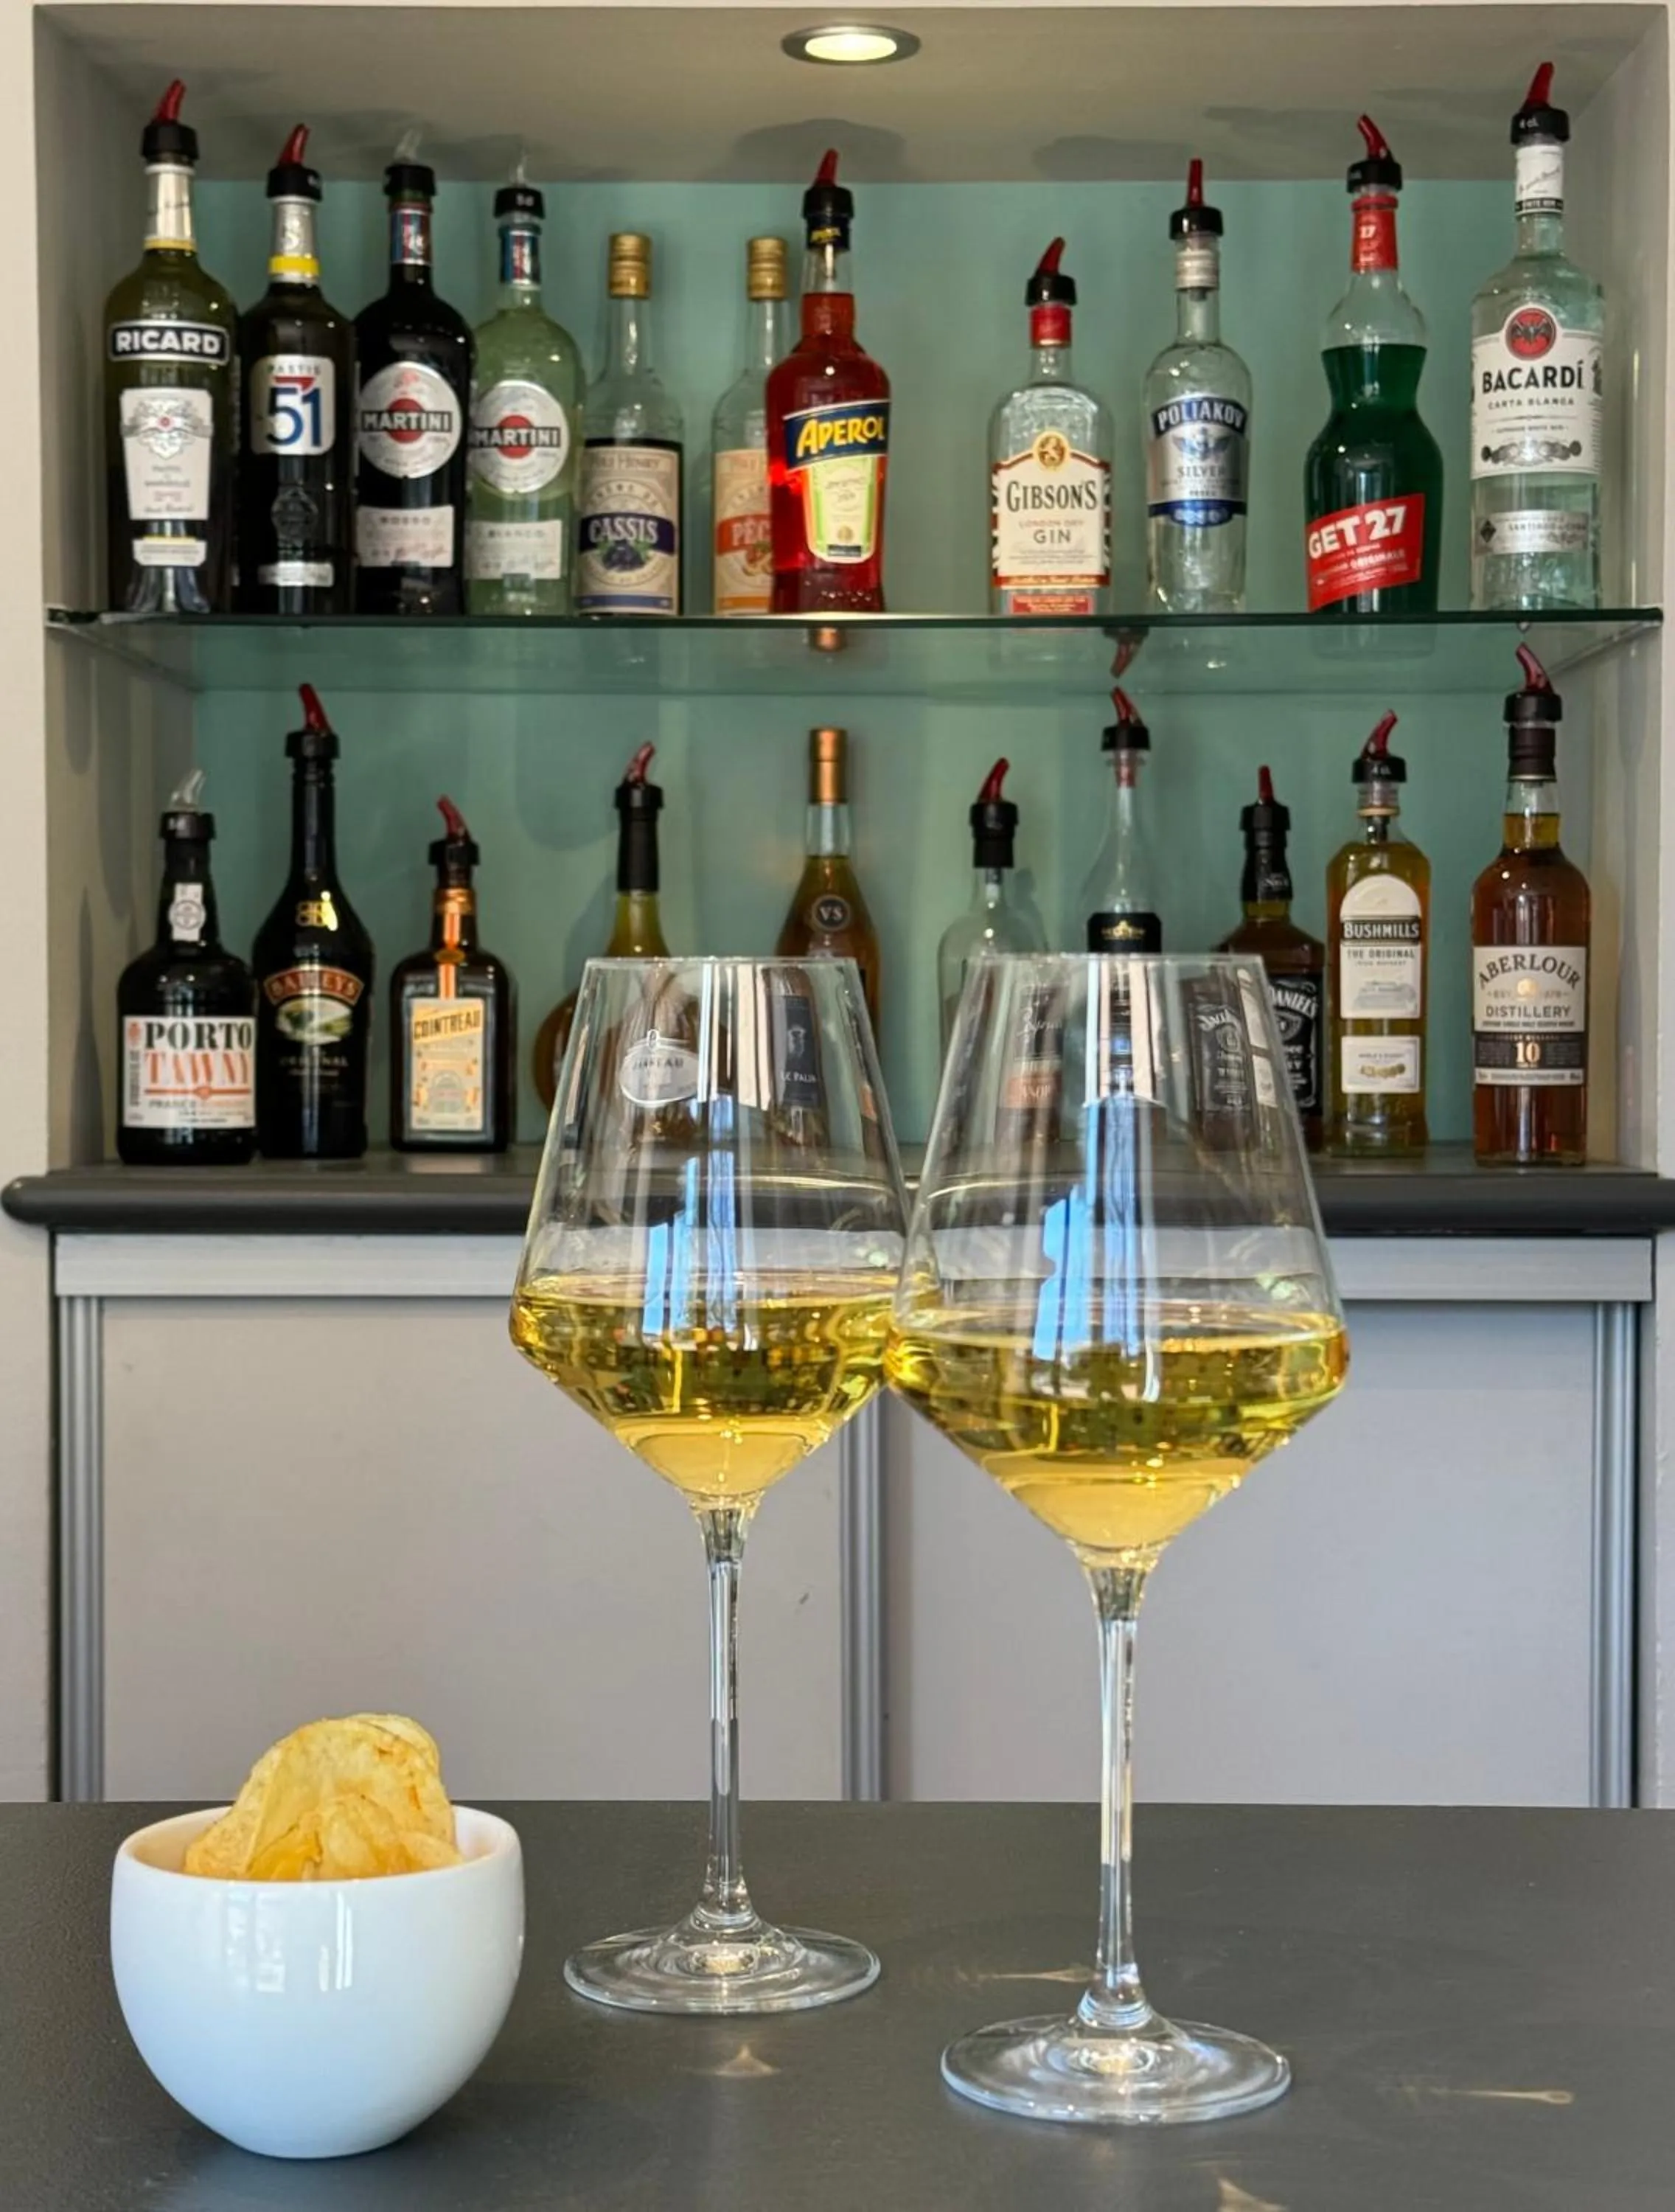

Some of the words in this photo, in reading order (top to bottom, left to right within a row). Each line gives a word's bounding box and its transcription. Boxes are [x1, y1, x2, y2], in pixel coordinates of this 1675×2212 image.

[116, 330, 221, 355] RICARD
[1482, 360, 1584, 394] BACARDÍ
[265, 386, 322, 448] 51
[363, 412, 452, 431] MARTINI
[1157, 400, 1244, 432] POLIAKOV
[475, 429, 559, 447] MARTINI
[796, 417, 885, 457] APEROL
[1006, 479, 1098, 512] GIBSON'S
[588, 516, 658, 544] CASSIS
[1033, 529, 1071, 544] GIN
[1309, 515, 1360, 560] GET
[1365, 505, 1407, 540] 27
[1343, 922, 1419, 939] BUSHMILLS
[1368, 948, 1415, 959] ORIGINAL
[1478, 953, 1581, 990] ABERLOUR
[414, 1009, 481, 1040] COINTREAU
[1486, 1004, 1571, 1018] DISTILLERY
[144, 1021, 253, 1050] PORTO
[1515, 1040, 1541, 1063] 10
